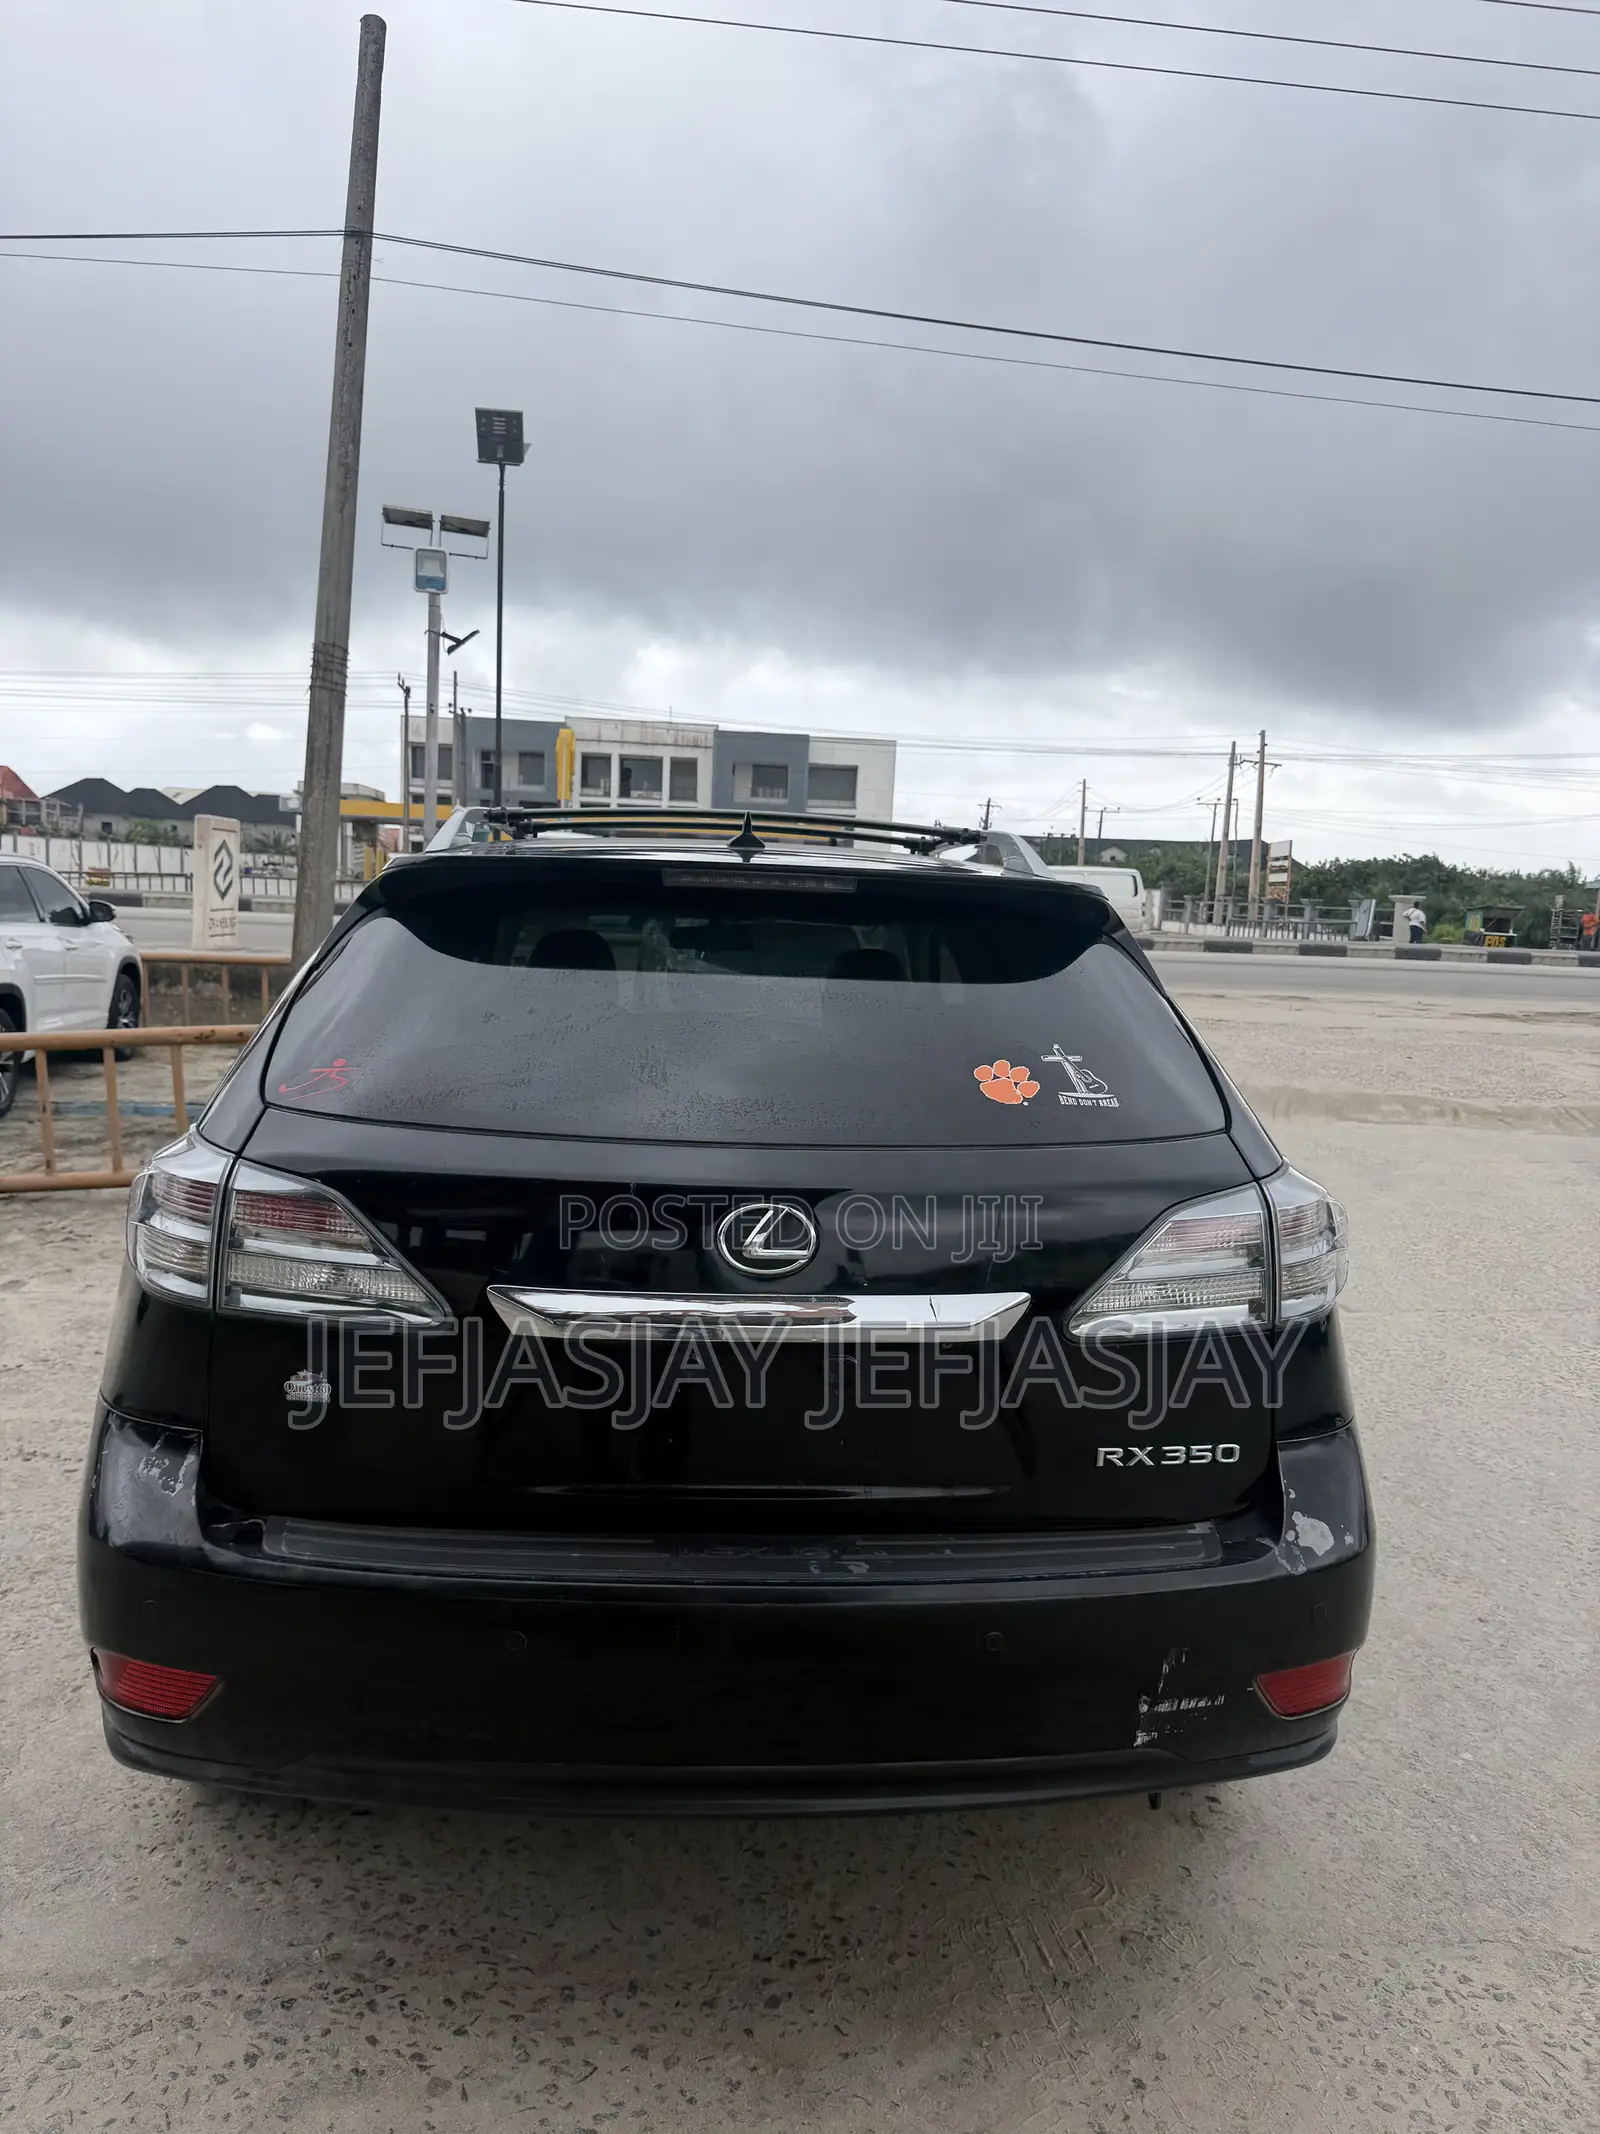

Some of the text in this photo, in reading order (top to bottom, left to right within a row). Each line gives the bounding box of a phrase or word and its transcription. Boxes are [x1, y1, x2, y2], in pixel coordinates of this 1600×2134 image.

[1058, 1094, 1078, 1106] BEND
[1098, 1097, 1120, 1108] BREAK
[1096, 1443, 1241, 1467] RX 350
